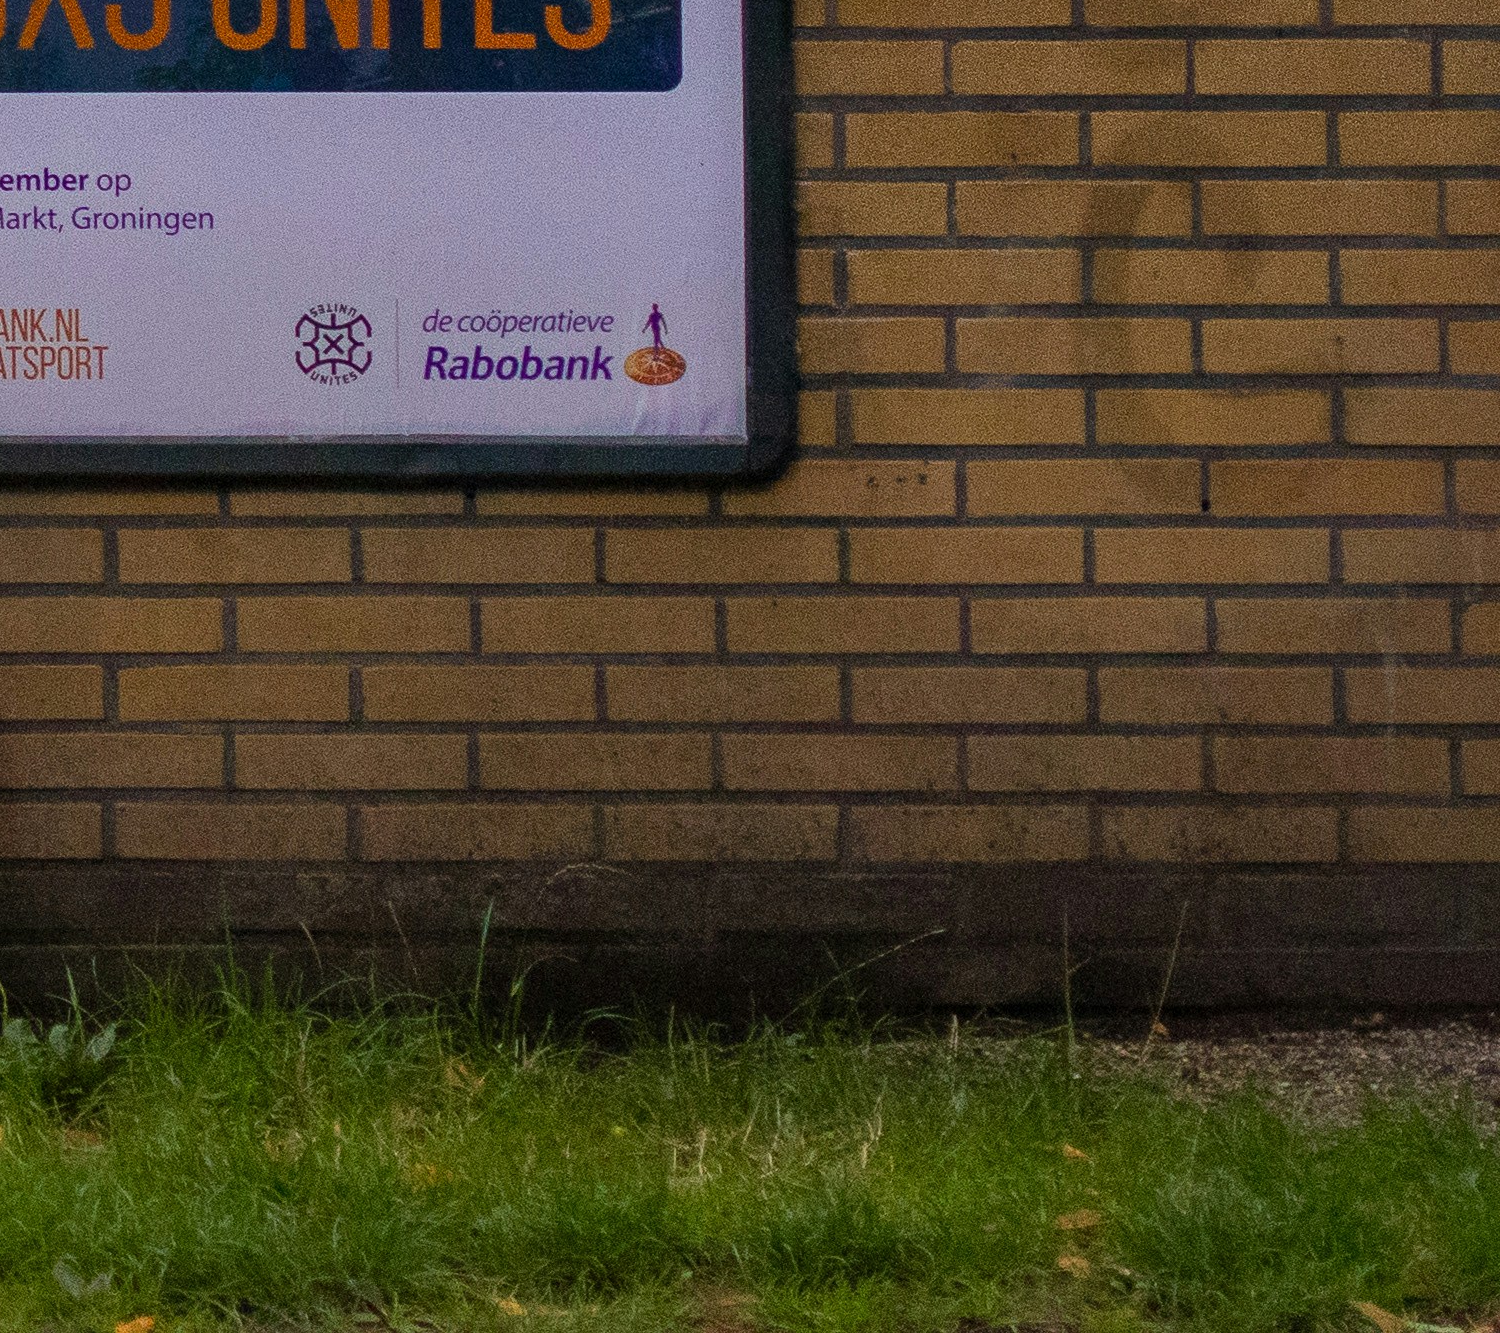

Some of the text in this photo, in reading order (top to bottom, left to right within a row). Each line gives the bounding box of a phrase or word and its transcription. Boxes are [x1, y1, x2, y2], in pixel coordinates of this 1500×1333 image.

[96, 173, 132, 197] op
[71, 206, 215, 236] Groningen
[309, 303, 357, 318] UNITES
[422, 308, 615, 338] de coöperatieve
[423, 345, 615, 381] Rabobank
[310, 370, 358, 386] UNITES
